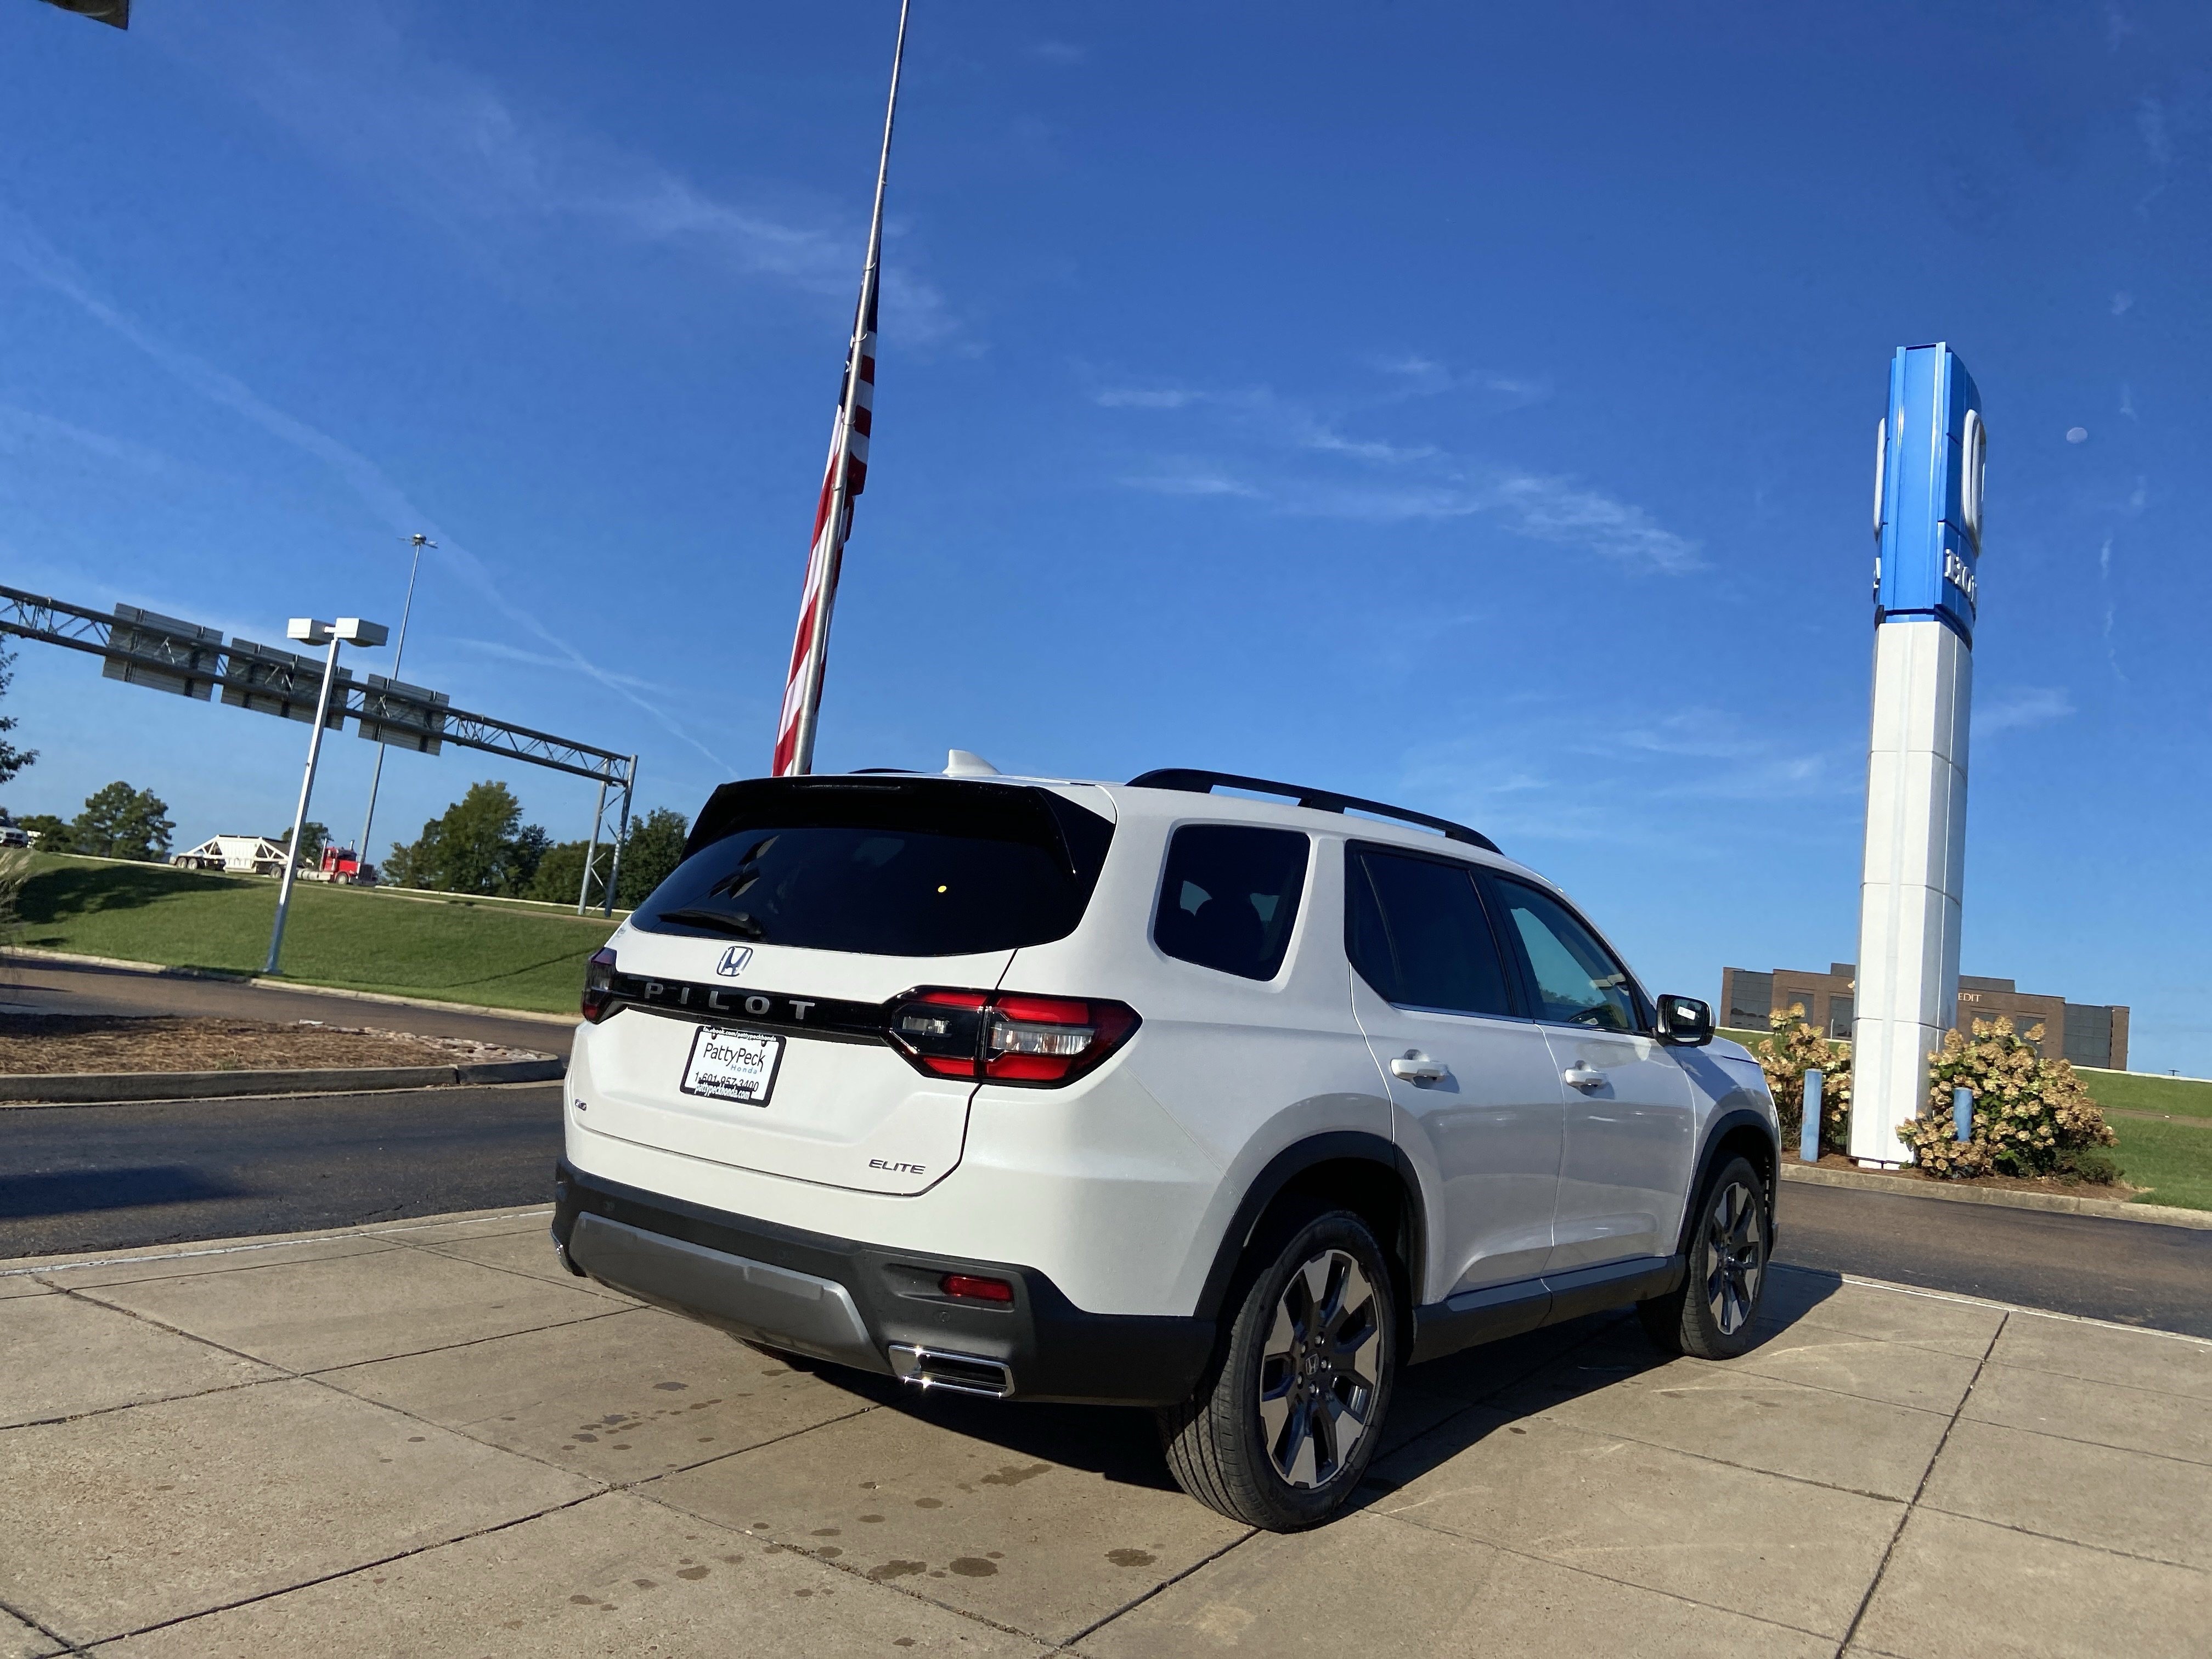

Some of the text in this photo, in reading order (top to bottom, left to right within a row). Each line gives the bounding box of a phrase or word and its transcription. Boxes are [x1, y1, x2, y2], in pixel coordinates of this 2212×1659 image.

[644, 983, 815, 1020] PILOT
[703, 1042, 766, 1073] PattyPeck
[731, 1064, 758, 1075] Honda
[694, 1082, 751, 1100] pattypeckhonda.com
[868, 1159, 926, 1175] ELITE
